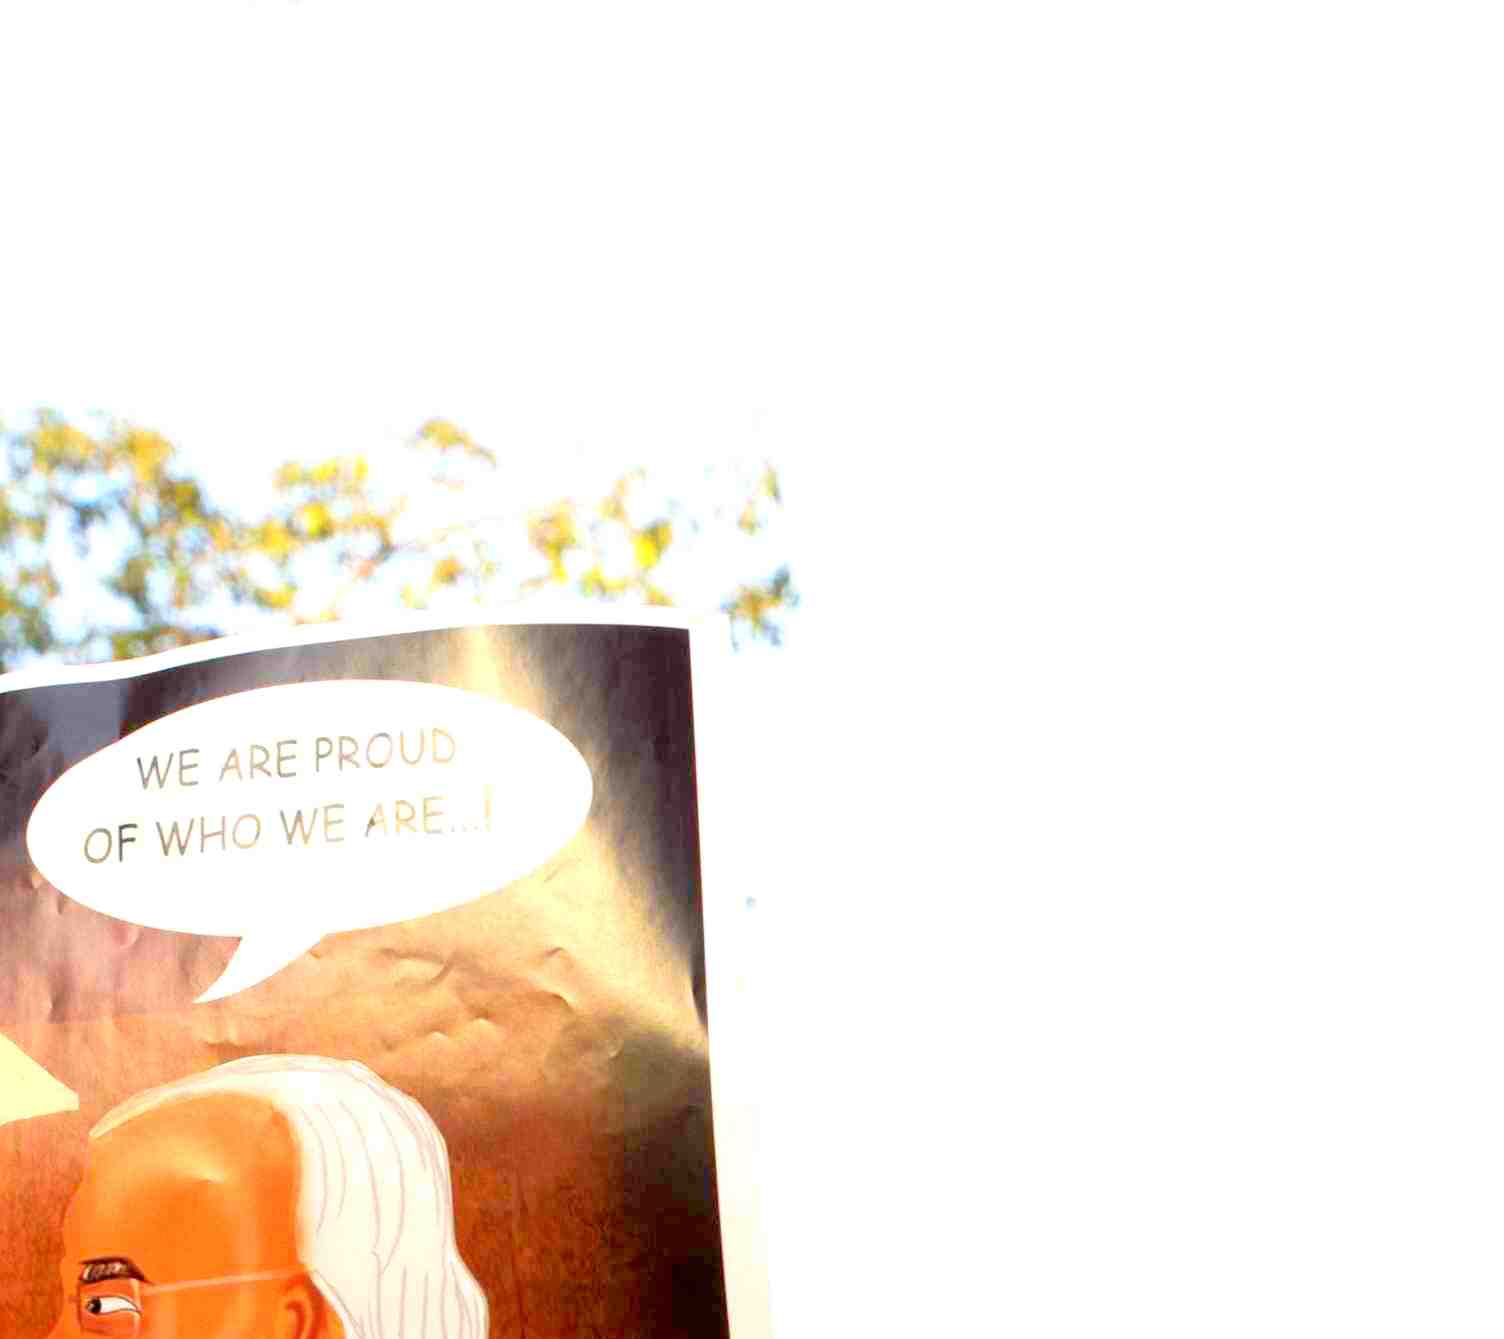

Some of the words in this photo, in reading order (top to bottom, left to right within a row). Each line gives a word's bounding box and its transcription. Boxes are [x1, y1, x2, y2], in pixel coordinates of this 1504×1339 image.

[137, 748, 201, 791] WE
[219, 739, 298, 782] ARE
[314, 728, 457, 772] PROUD
[82, 823, 139, 864] OF
[155, 812, 262, 857] WHO
[279, 802, 346, 846] WE
